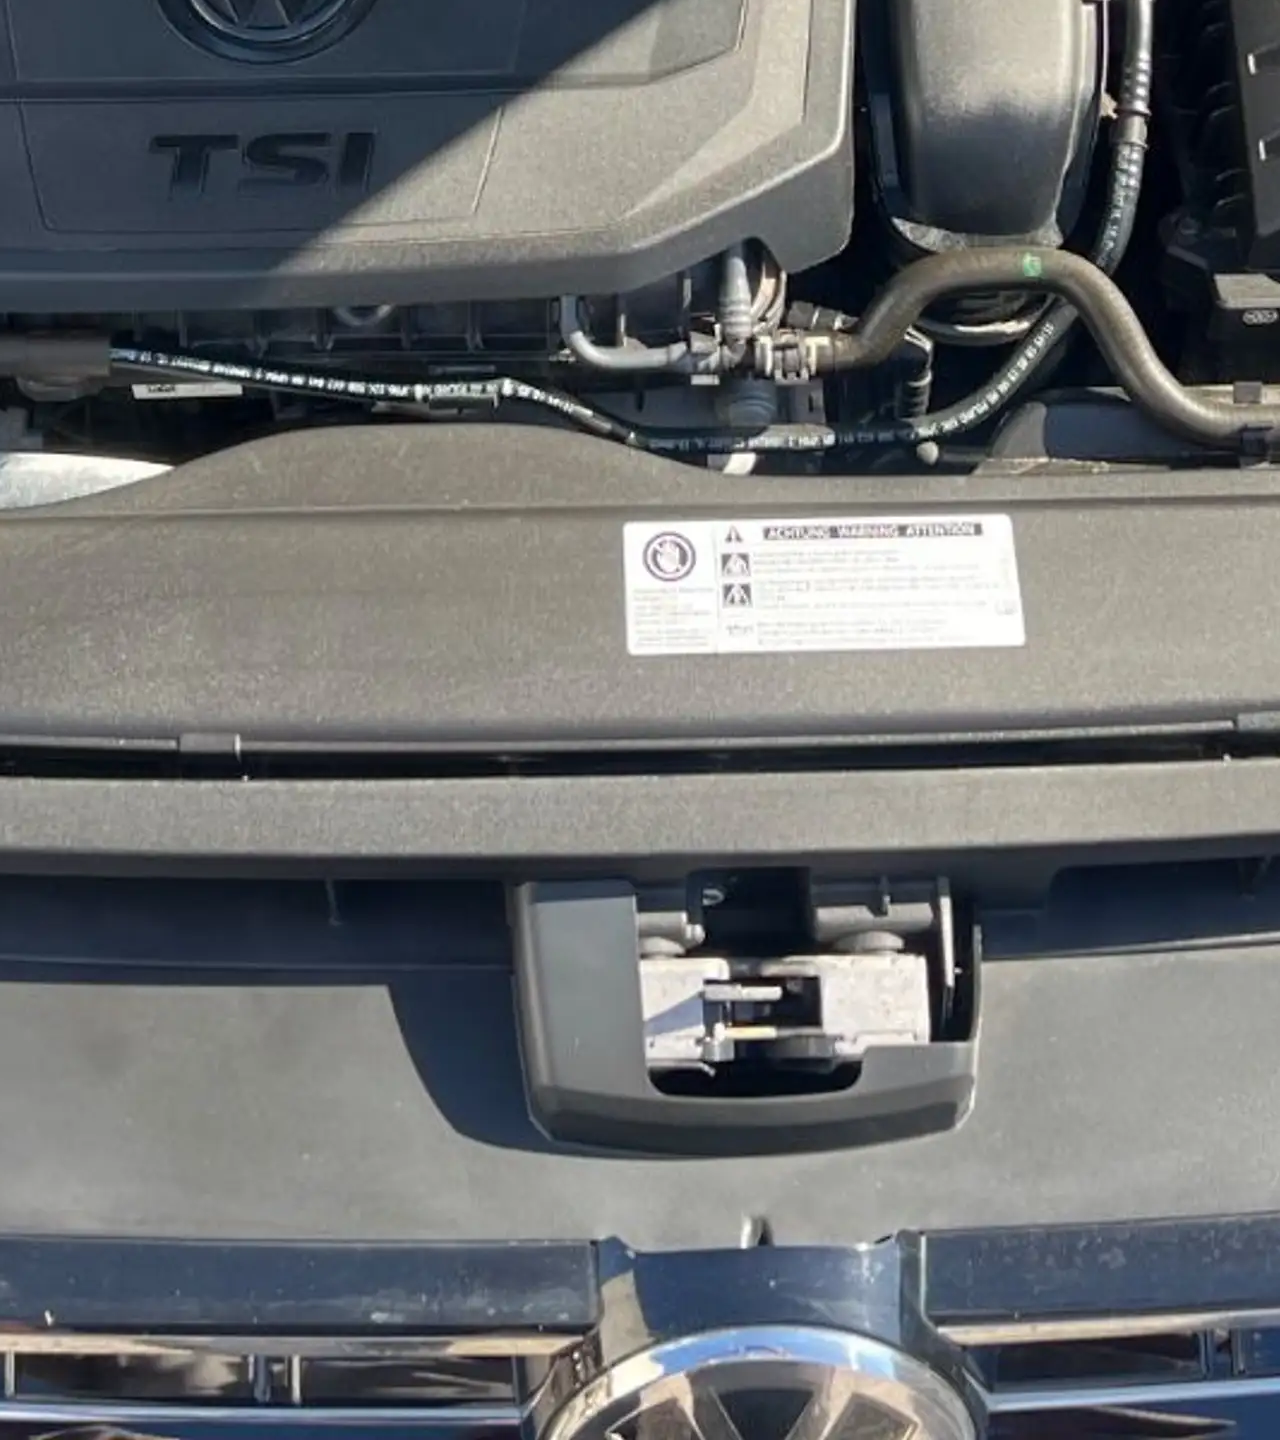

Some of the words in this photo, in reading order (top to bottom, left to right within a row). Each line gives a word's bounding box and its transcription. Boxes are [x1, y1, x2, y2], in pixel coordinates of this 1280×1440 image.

[150, 131, 376, 190] TSI
[768, 525, 827, 540] ACHTUNG
[838, 524, 898, 538] WARNING
[906, 522, 975, 537] ATTENTION
